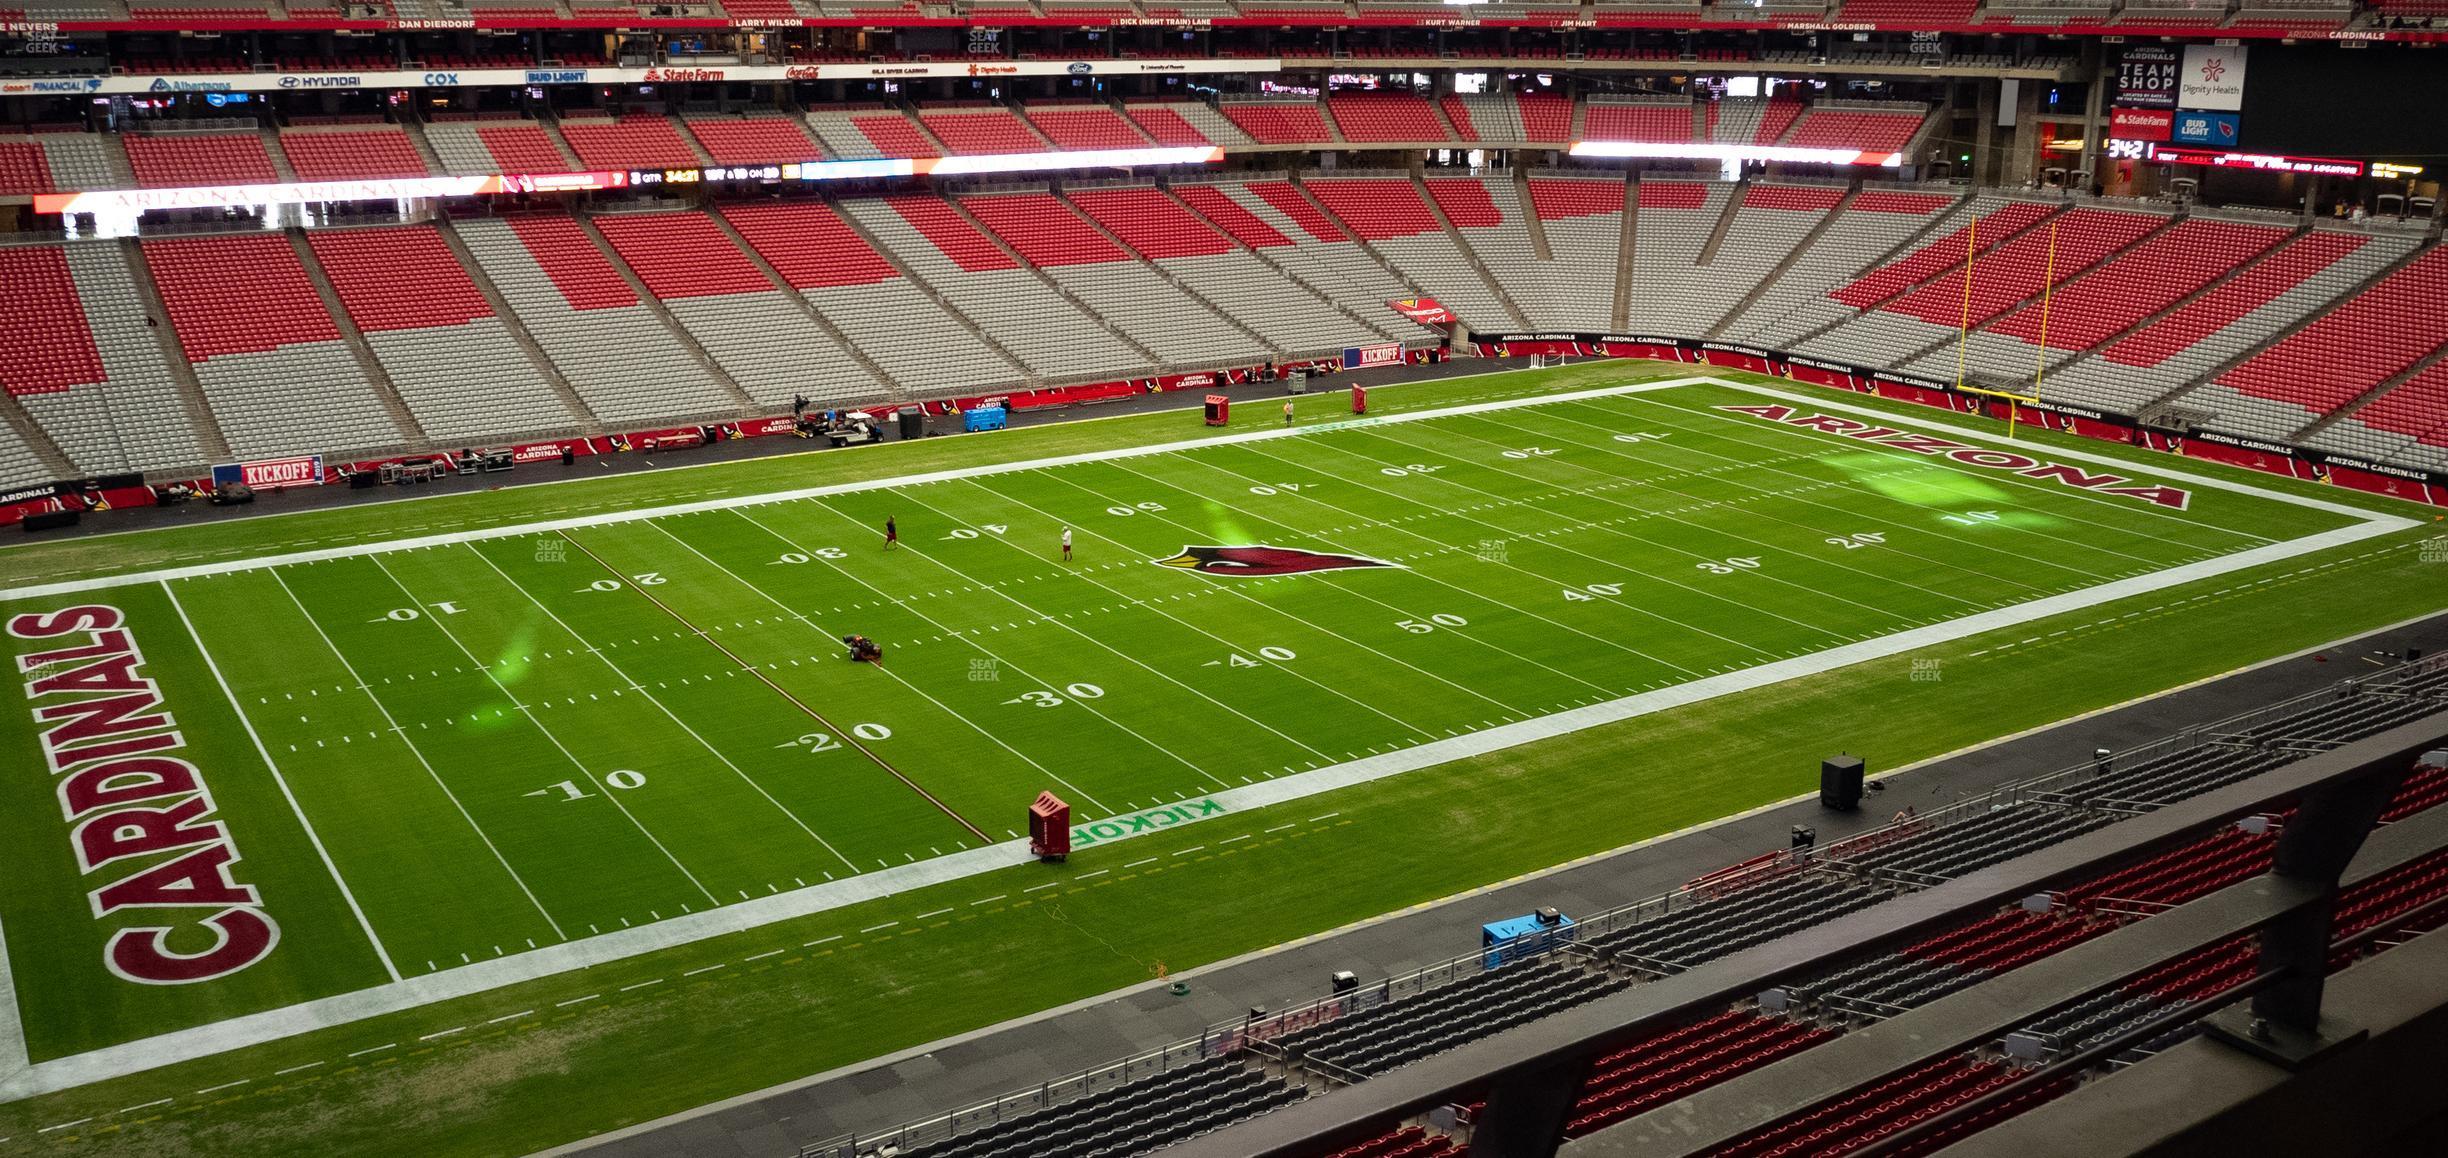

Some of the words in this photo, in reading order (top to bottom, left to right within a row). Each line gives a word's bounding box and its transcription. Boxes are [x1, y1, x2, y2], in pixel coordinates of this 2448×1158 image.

[10, 22, 59, 31] NEVERS
[399, 20, 421, 29] DAN
[424, 20, 476, 29] DIERDORF
[1120, 18, 1137, 26] DICK
[1139, 18, 1164, 26] (NIGHT
[1166, 18, 1191, 26] TRAIN)
[1192, 18, 1211, 26] LANE
[1787, 22, 1831, 30] MARSHALL
[2329, 32, 2385, 40] CARDINALS
[528, 72, 551, 82] BUD
[553, 72, 585, 82] LIGHT
[2121, 63, 2175, 77] TEAM
[303, 76, 361, 86] HYUNDAI
[424, 74, 459, 85] COX
[2119, 76, 2174, 90] SHOP
[2182, 84, 2211, 96] Dignity
[2213, 85, 2239, 94] Health
[2181, 127, 2209, 136] LIGHT
[2185, 119, 2206, 128] BUD
[116, 189, 249, 206] ARIZONA
[1634, 337, 1677, 346] CARDINALS
[1362, 347, 1398, 363] KICKOFF
[1702, 343, 1734, 352] ARIZONA
[1735, 347, 1768, 358] CARDINALS
[1787, 356, 1815, 366] ARIZONA
[1816, 362, 1852, 372] CARDINALS
[1176, 378, 1214, 388] CARDINALS
[1873, 372, 1904, 382] ARIZONA
[1905, 378, 1944, 390] CARDINALS
[2021, 400, 2056, 411] ARIZONA
[2057, 405, 2100, 419] CARDINALS
[526, 444, 558, 453] ARIZONA
[2200, 432, 2240, 446] ARIZONA
[2241, 440, 2292, 454] CARDINALS
[516, 449, 562, 460] CARDINAL
[1710, 404, 2192, 511] ARIZONA
[246, 462, 310, 484] KICKOFF
[2325, 455, 2368, 469] ARIZONA
[2370, 464, 2428, 480] CARDINALS
[1825, 532, 1886, 550] 20
[1696, 557, 1761, 574] 30
[1562, 583, 1622, 602] 40
[1395, 613, 1468, 634] 50
[1229, 646, 1296, 668] 40
[1020, 682, 1104, 708] 30
[798, 723, 892, 753] 20
[546, 769, 647, 802] 10
[5, 604, 282, 986] CARDINALS
[1070, 798, 1226, 847] KICKOF
